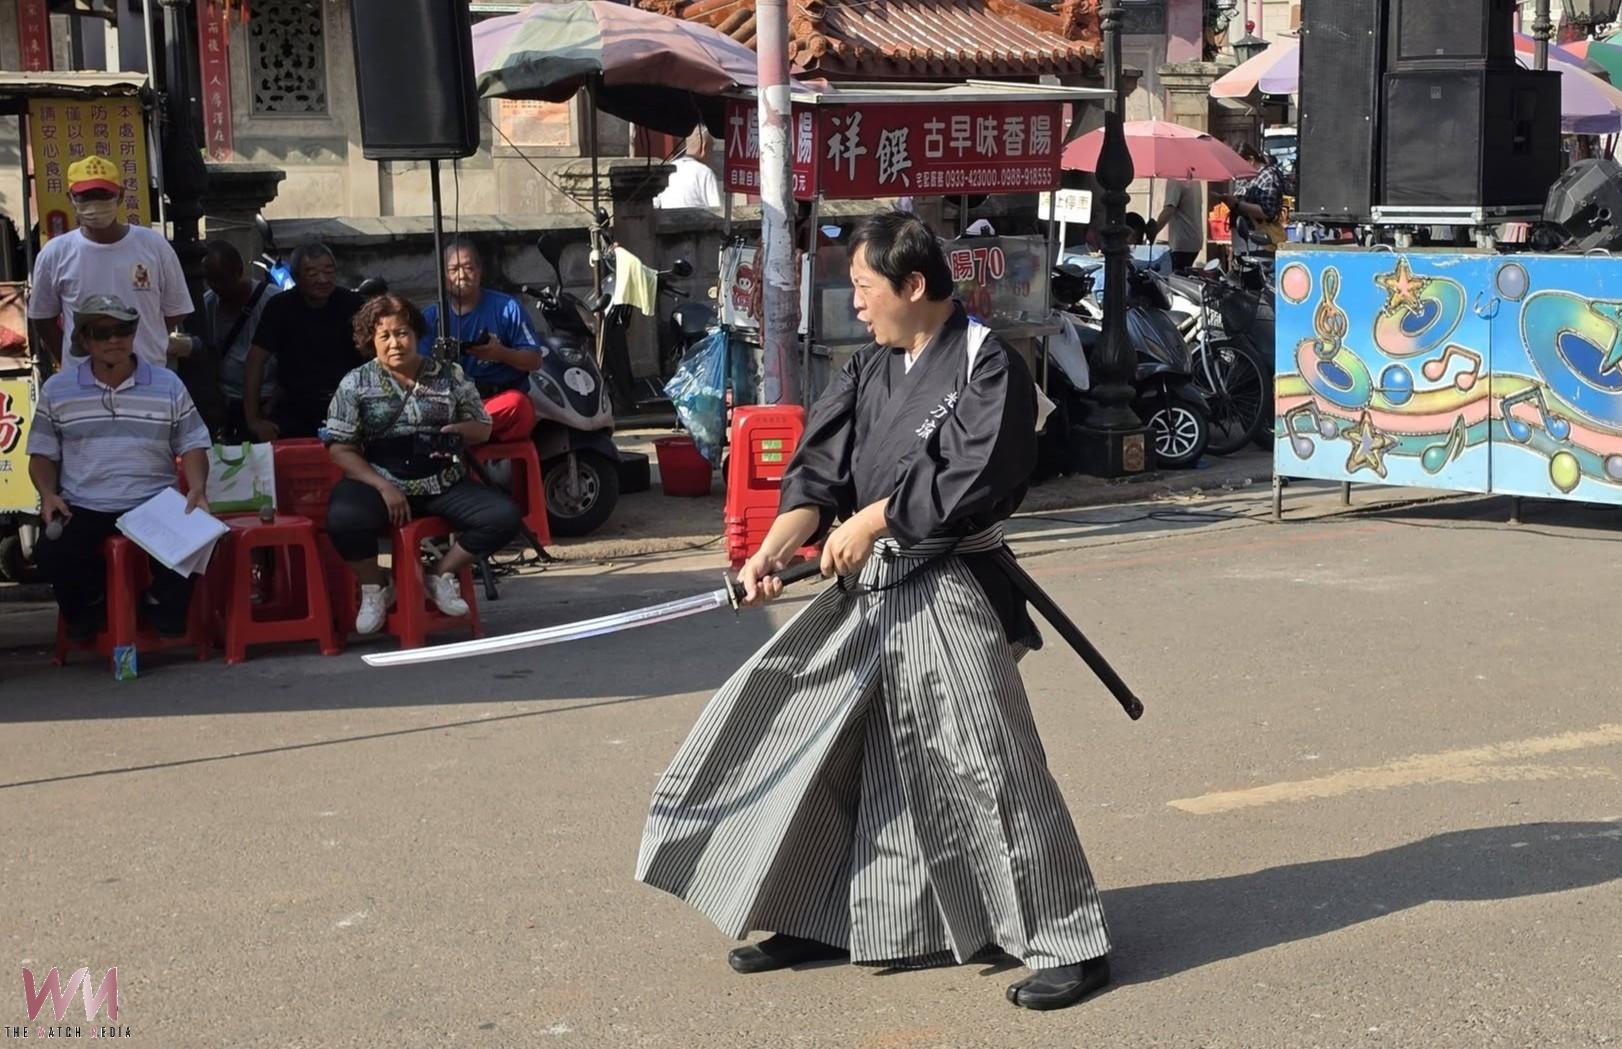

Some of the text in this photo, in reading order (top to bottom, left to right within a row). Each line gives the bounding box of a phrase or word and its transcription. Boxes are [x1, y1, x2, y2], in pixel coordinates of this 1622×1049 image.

[923, 115, 1052, 158] 古早味香腸
[915, 391, 958, 440] 光刀流
